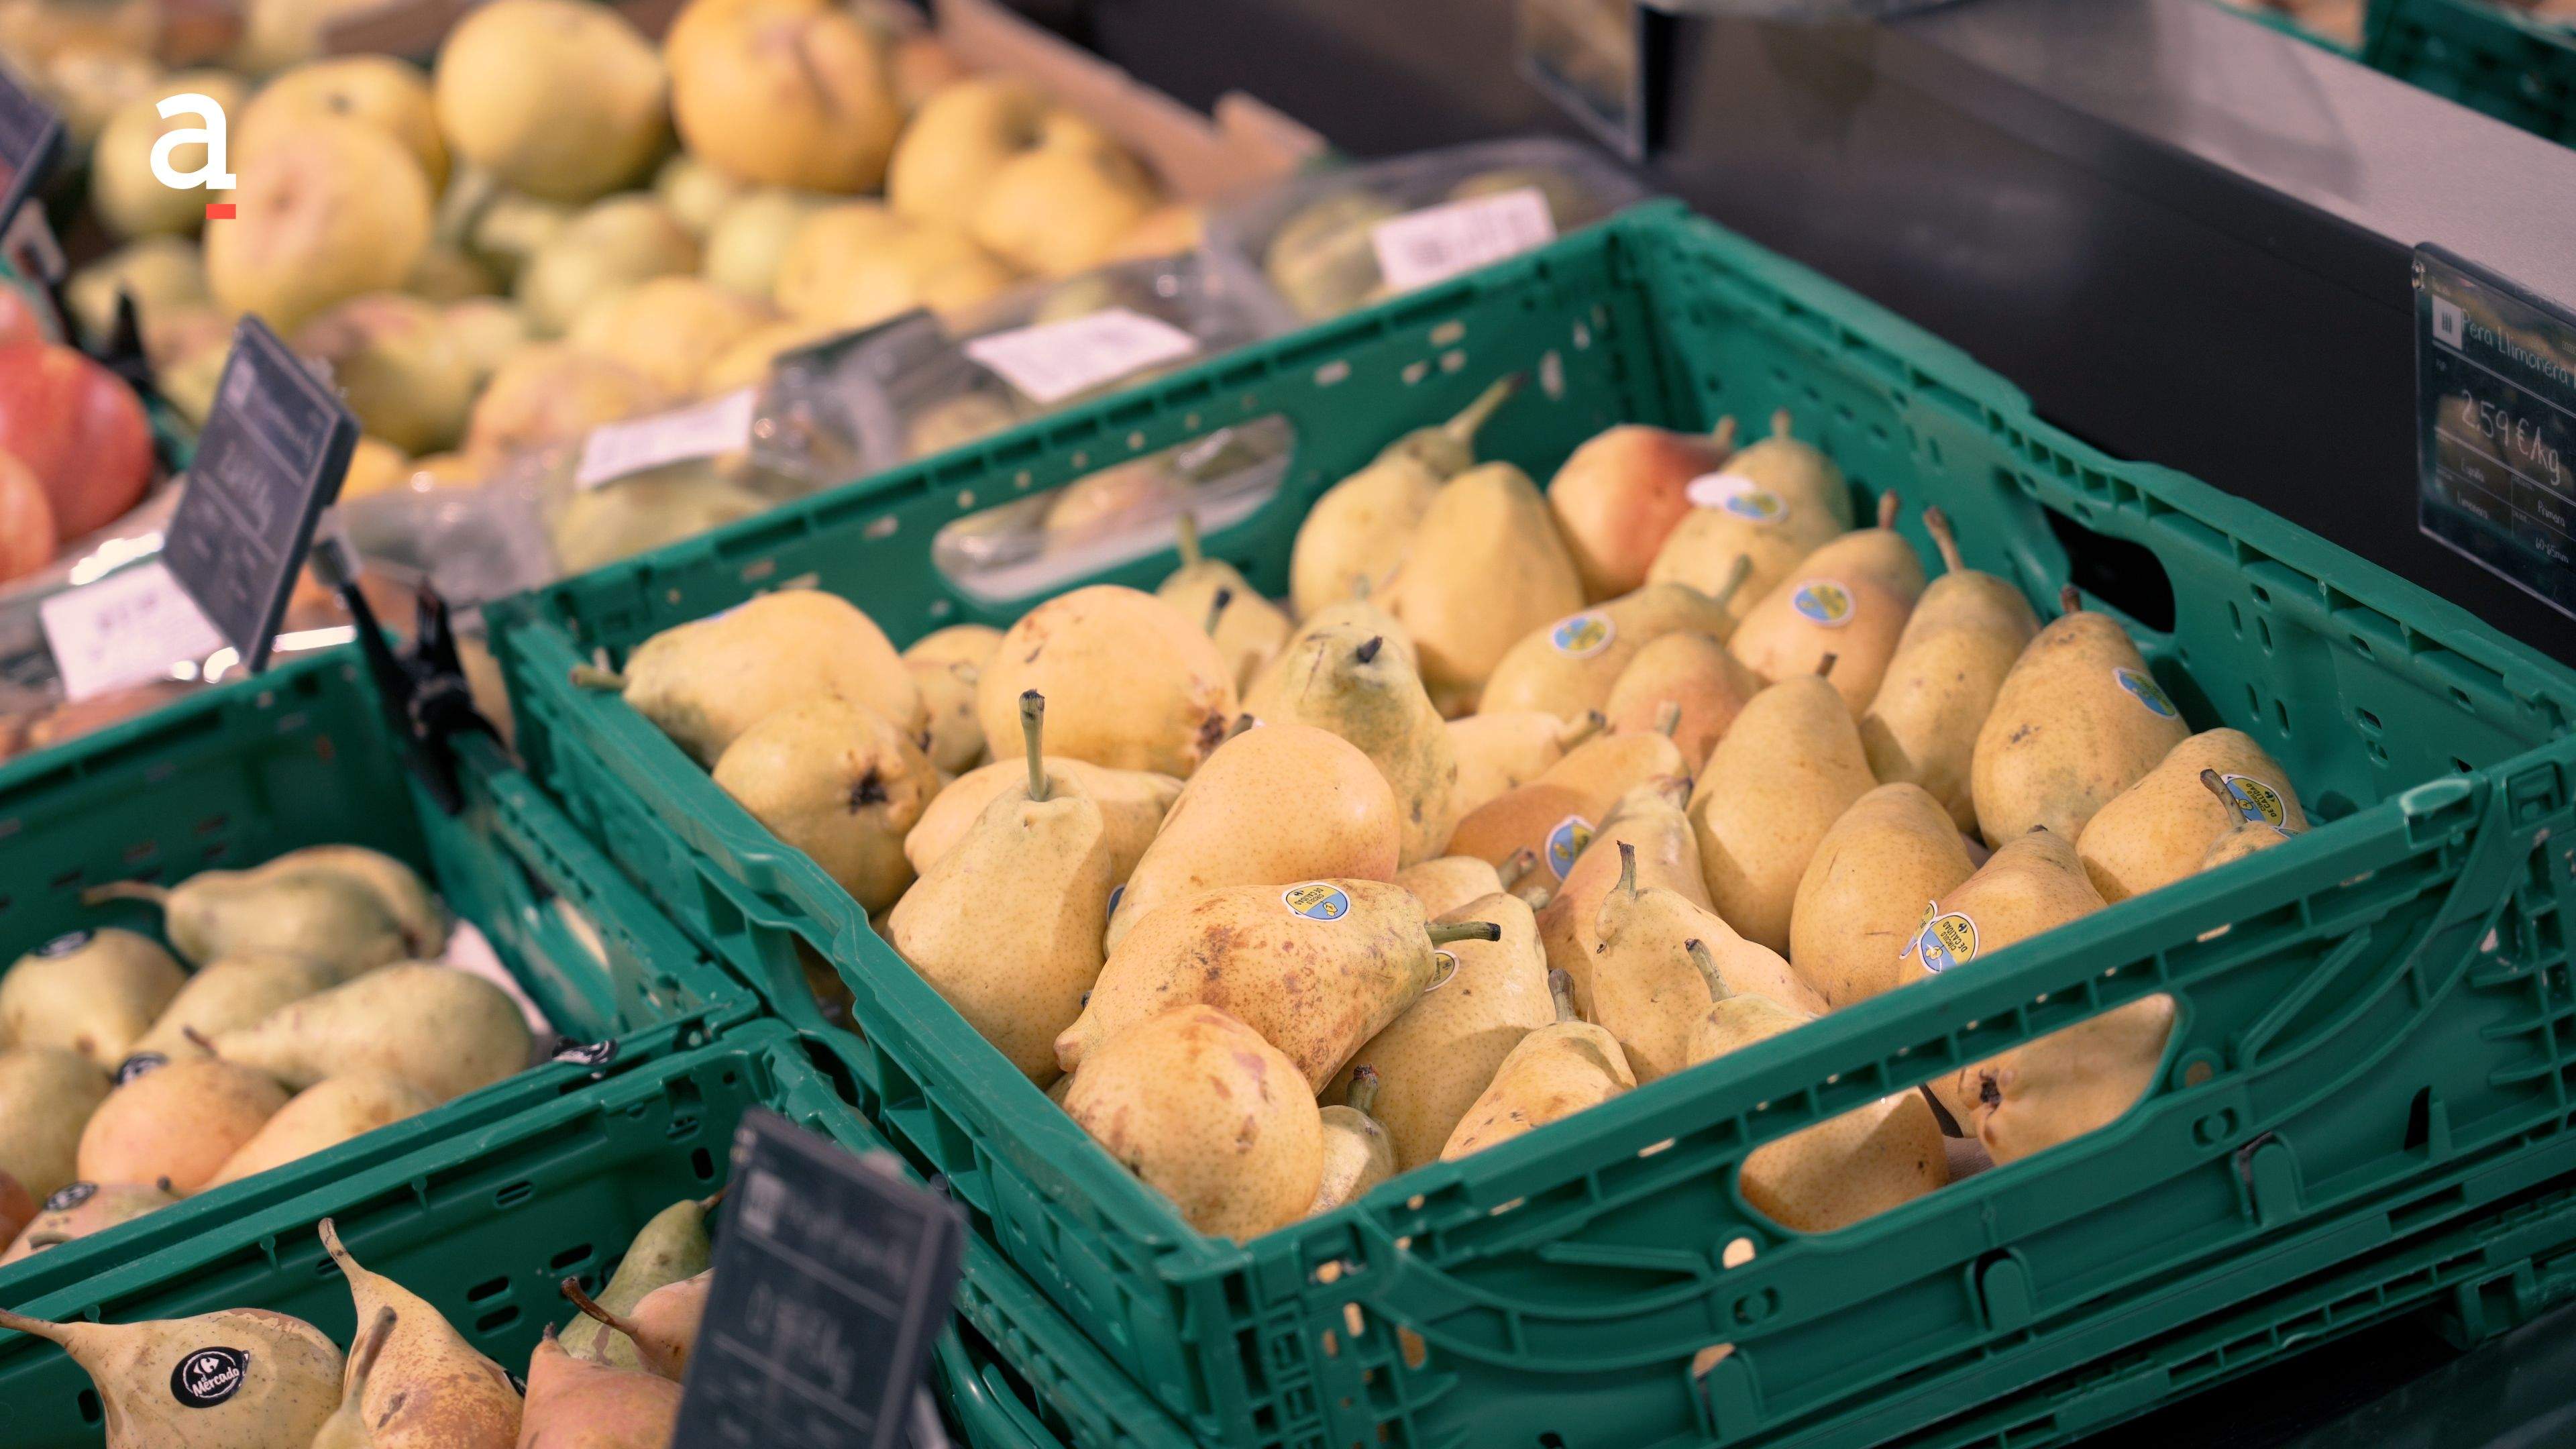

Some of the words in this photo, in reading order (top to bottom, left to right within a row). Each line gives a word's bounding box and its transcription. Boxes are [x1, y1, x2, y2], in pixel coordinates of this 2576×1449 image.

[2463, 309, 2492, 346] Pera
[1943, 922, 1962, 945] CALIDAD
[1959, 943, 1968, 953] DE
[192, 1366, 239, 1397] Mercado
